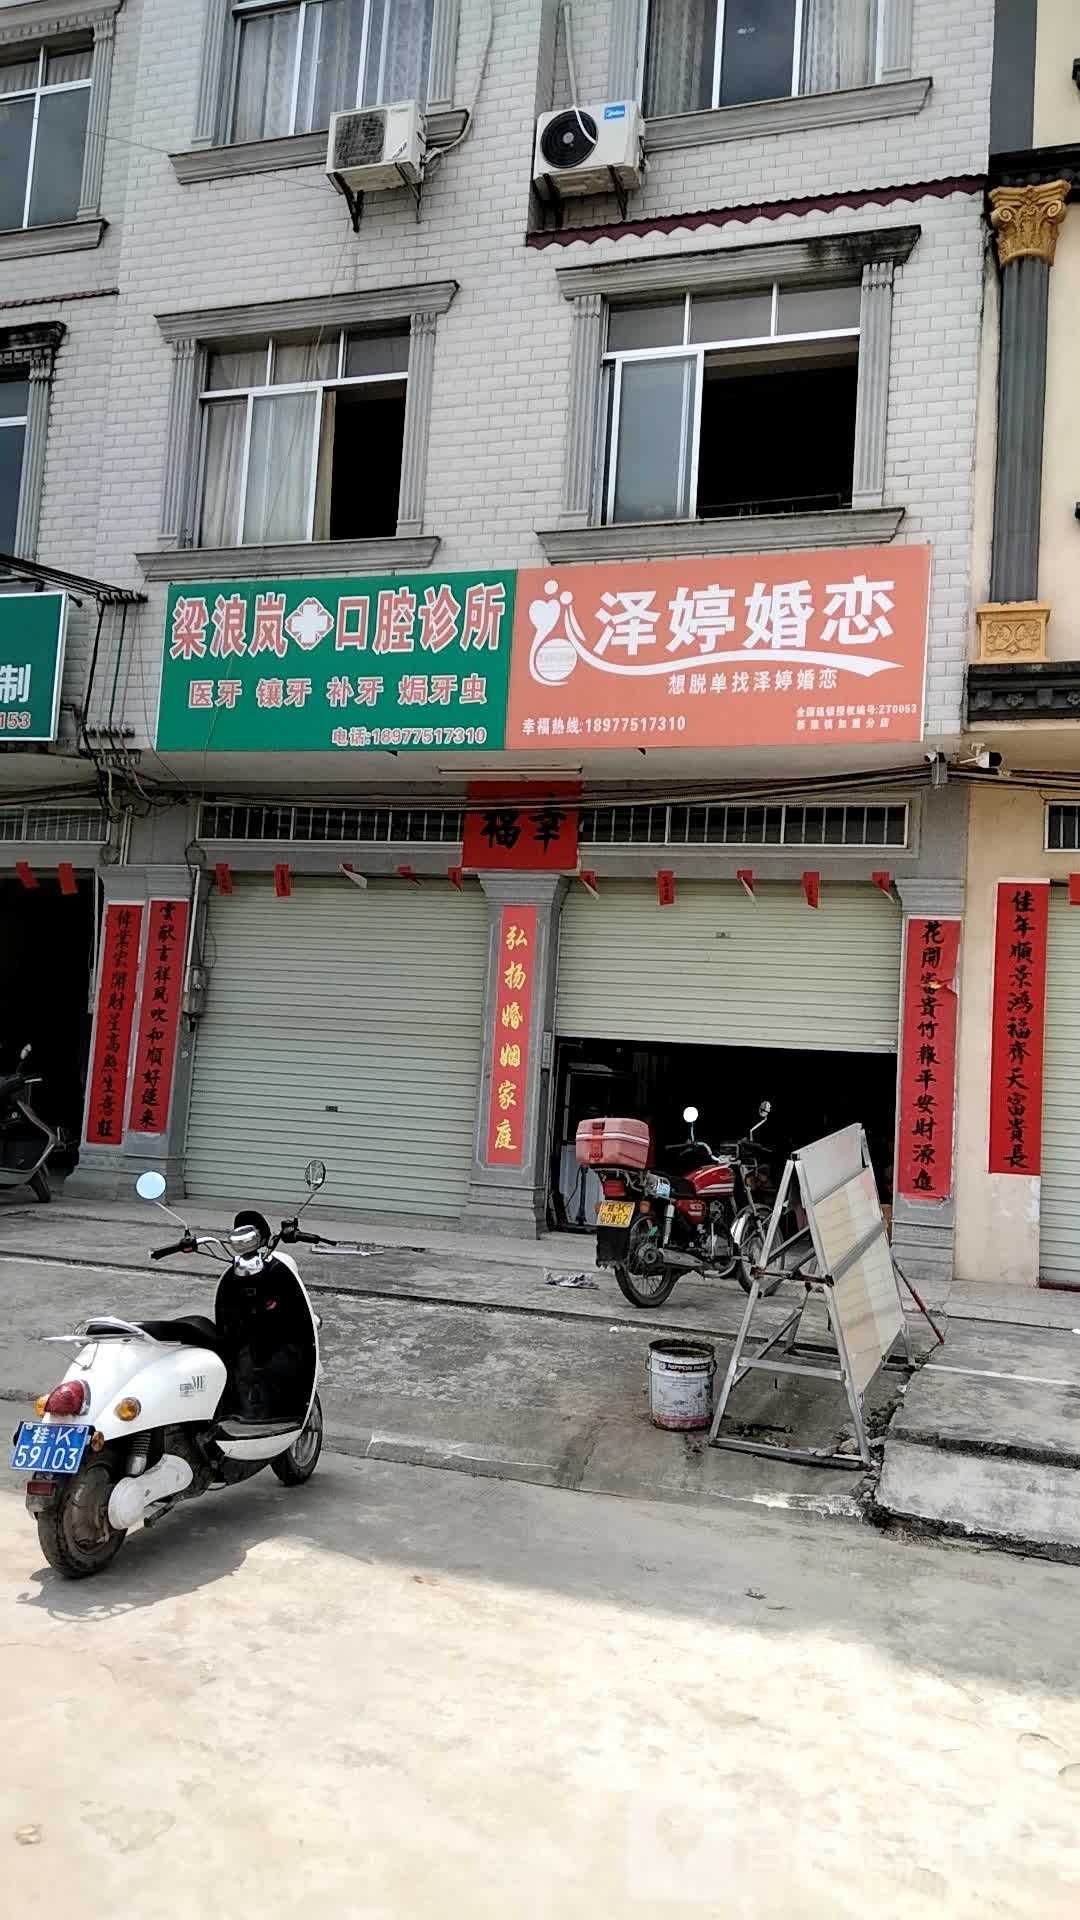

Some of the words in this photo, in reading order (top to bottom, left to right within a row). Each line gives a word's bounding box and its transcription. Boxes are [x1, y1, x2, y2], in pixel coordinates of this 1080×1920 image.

[169, 592, 288, 659] 梁浪岚
[335, 582, 506, 656] 口腔诊所
[593, 574, 895, 655] 泽婷婚恋
[188, 679, 242, 708] 医牙
[256, 678, 312, 708] 镶牙
[327, 676, 384, 707] 补牙
[398, 673, 488, 706] 焗牙虫
[668, 668, 838, 695] 想脱单找泽婷婚恋
[331, 727, 487, 746] 电话:18977517310
[522, 715, 686, 736] 幸福热线:18977517310
[494, 925, 528, 1151] 弘扬婚姻家庭
[15, 1444, 79, 1470] 59103
